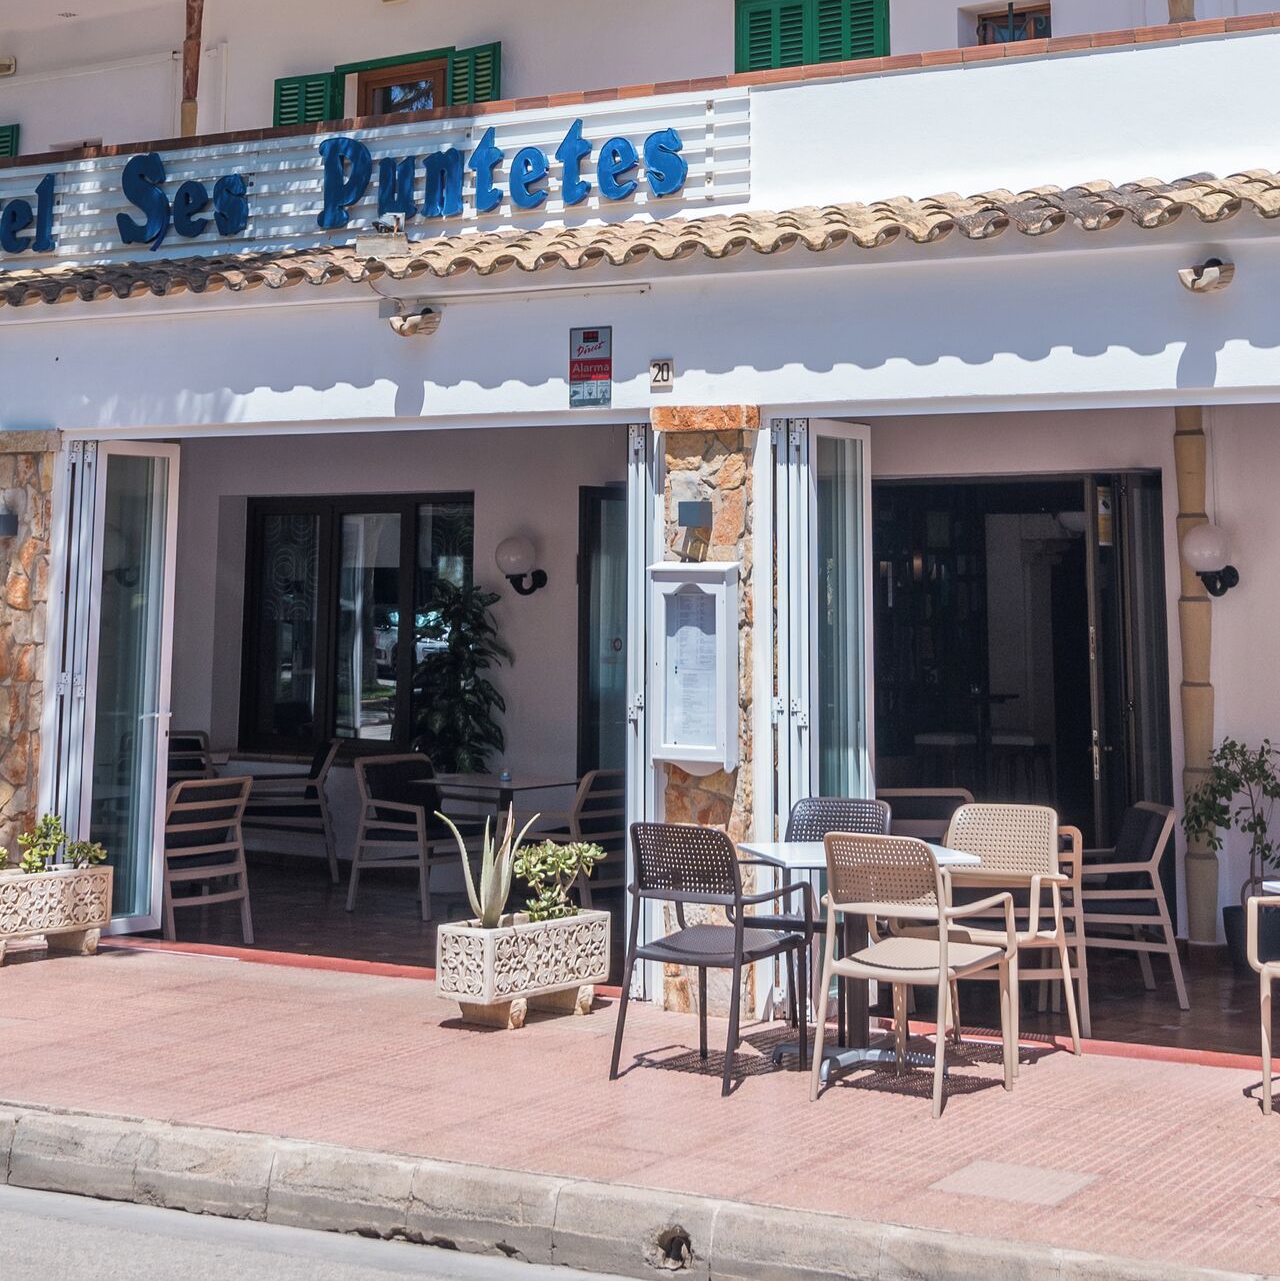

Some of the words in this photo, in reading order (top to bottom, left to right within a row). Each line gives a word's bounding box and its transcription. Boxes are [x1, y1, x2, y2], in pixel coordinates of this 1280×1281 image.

[116, 152, 249, 252] Ses
[317, 118, 688, 229] Puntetes
[576, 340, 606, 357] Direct
[572, 362, 610, 373] Alarma
[652, 362, 670, 382] 20
